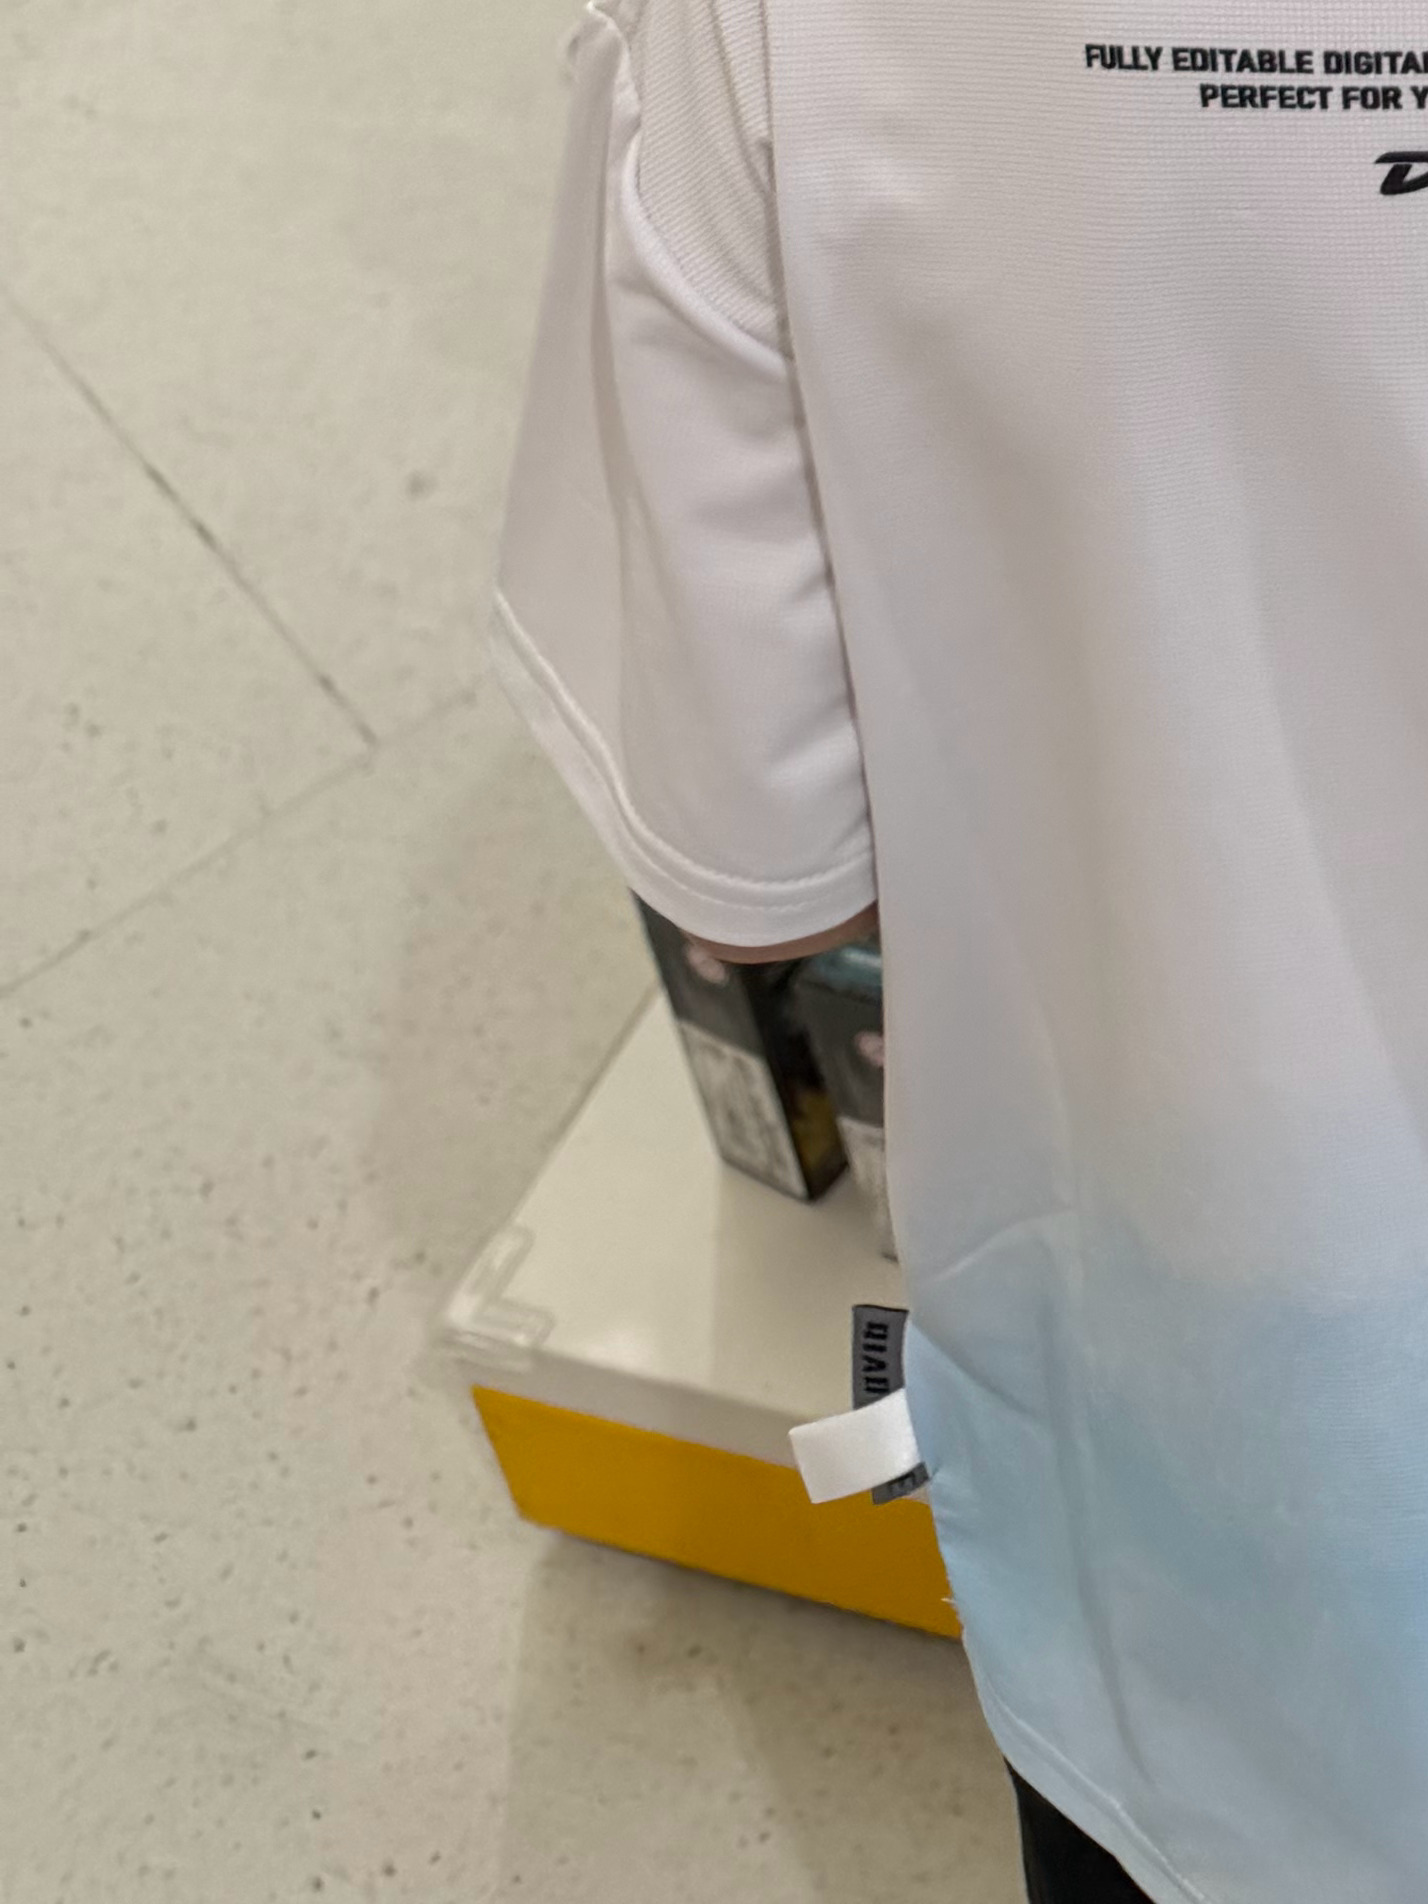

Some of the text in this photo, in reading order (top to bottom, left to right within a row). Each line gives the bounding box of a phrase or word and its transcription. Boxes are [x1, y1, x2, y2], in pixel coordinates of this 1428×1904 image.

[1085, 43, 1163, 71] FULLY
[1171, 46, 1313, 75] EDITABLE
[1199, 85, 1333, 112] PERFECT
[1341, 85, 1402, 110] FOR
